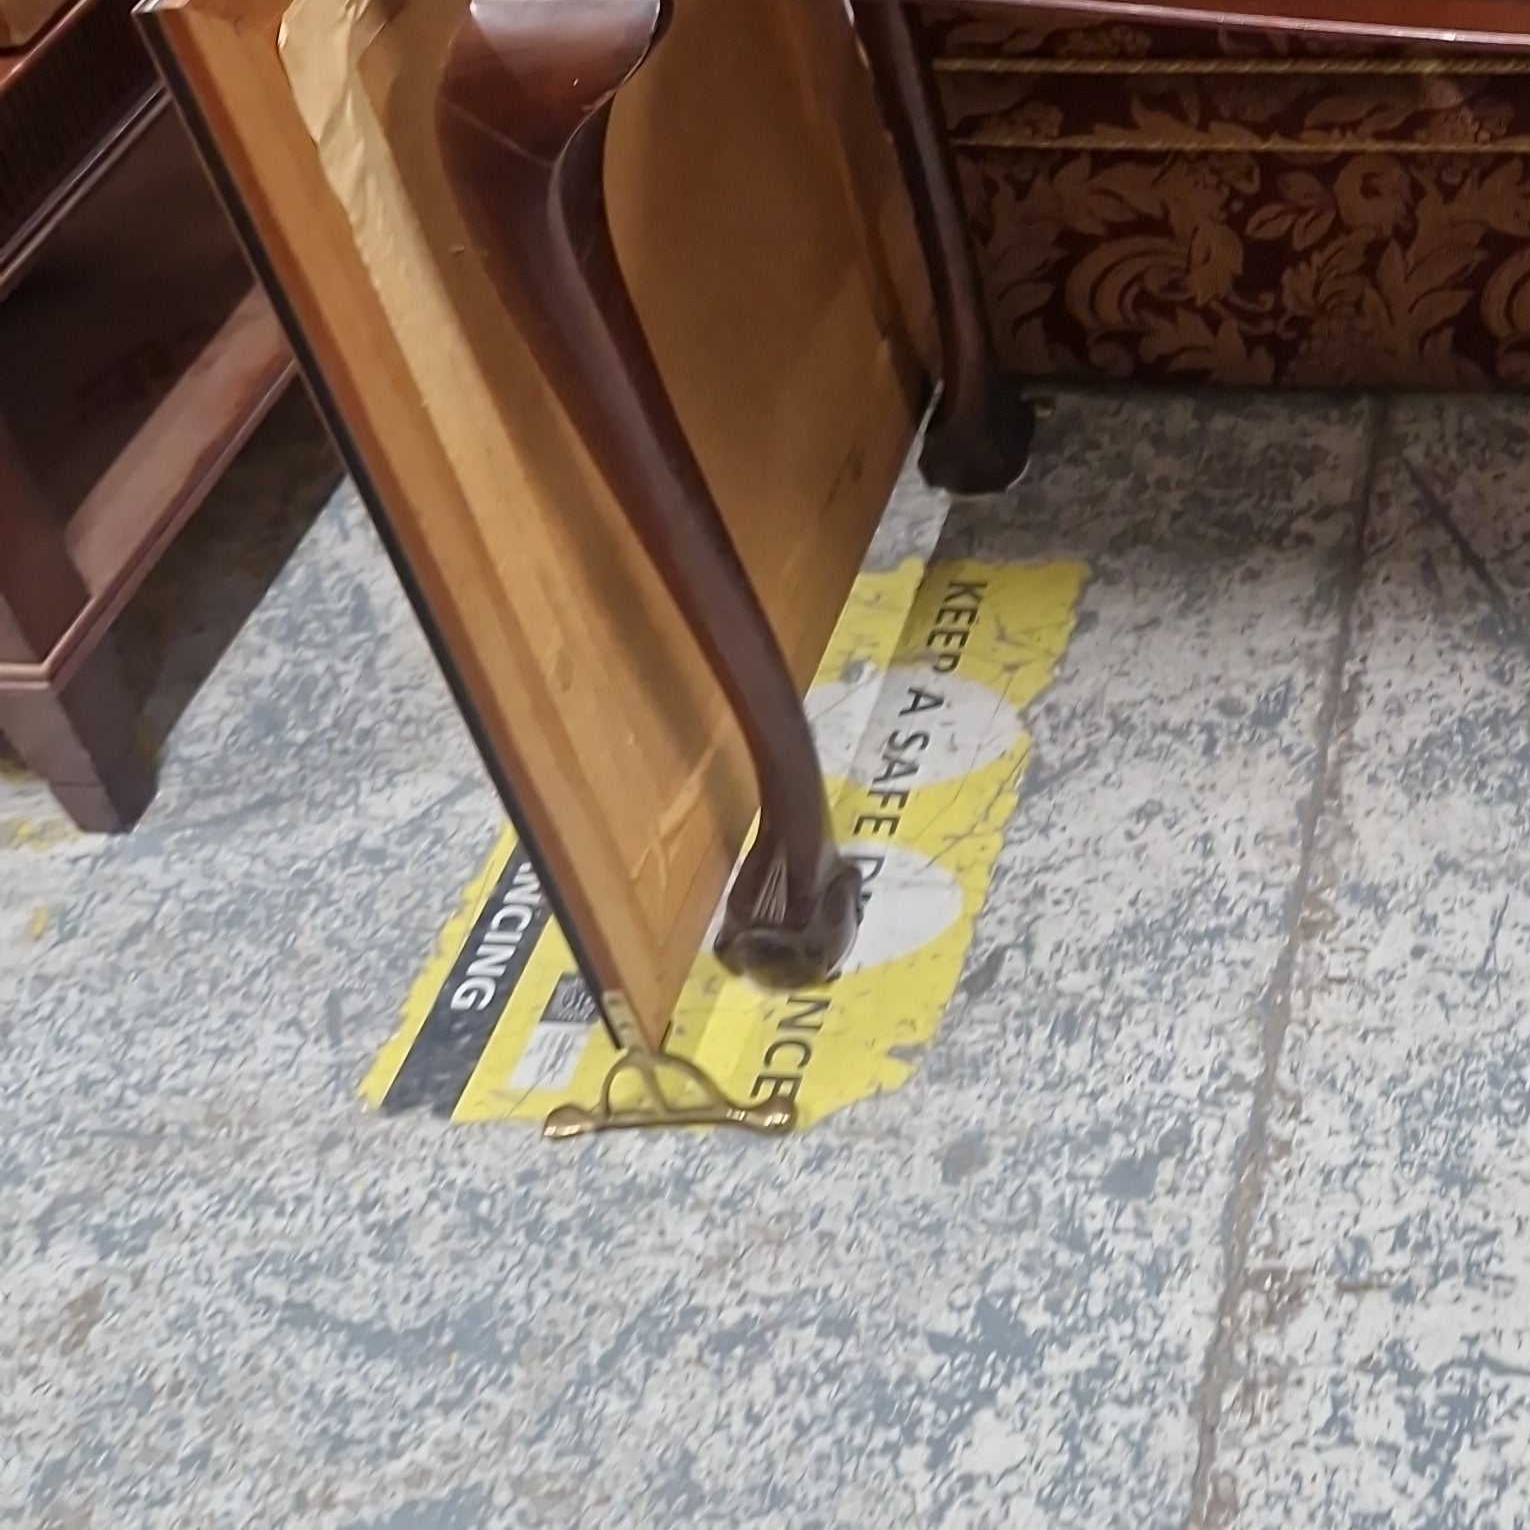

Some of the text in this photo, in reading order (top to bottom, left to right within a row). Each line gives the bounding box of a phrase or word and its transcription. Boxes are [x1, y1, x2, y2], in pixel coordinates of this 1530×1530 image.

[926, 581, 988, 673] KEEP
[898, 687, 944, 717] A
[852, 729, 930, 837] SAFE
